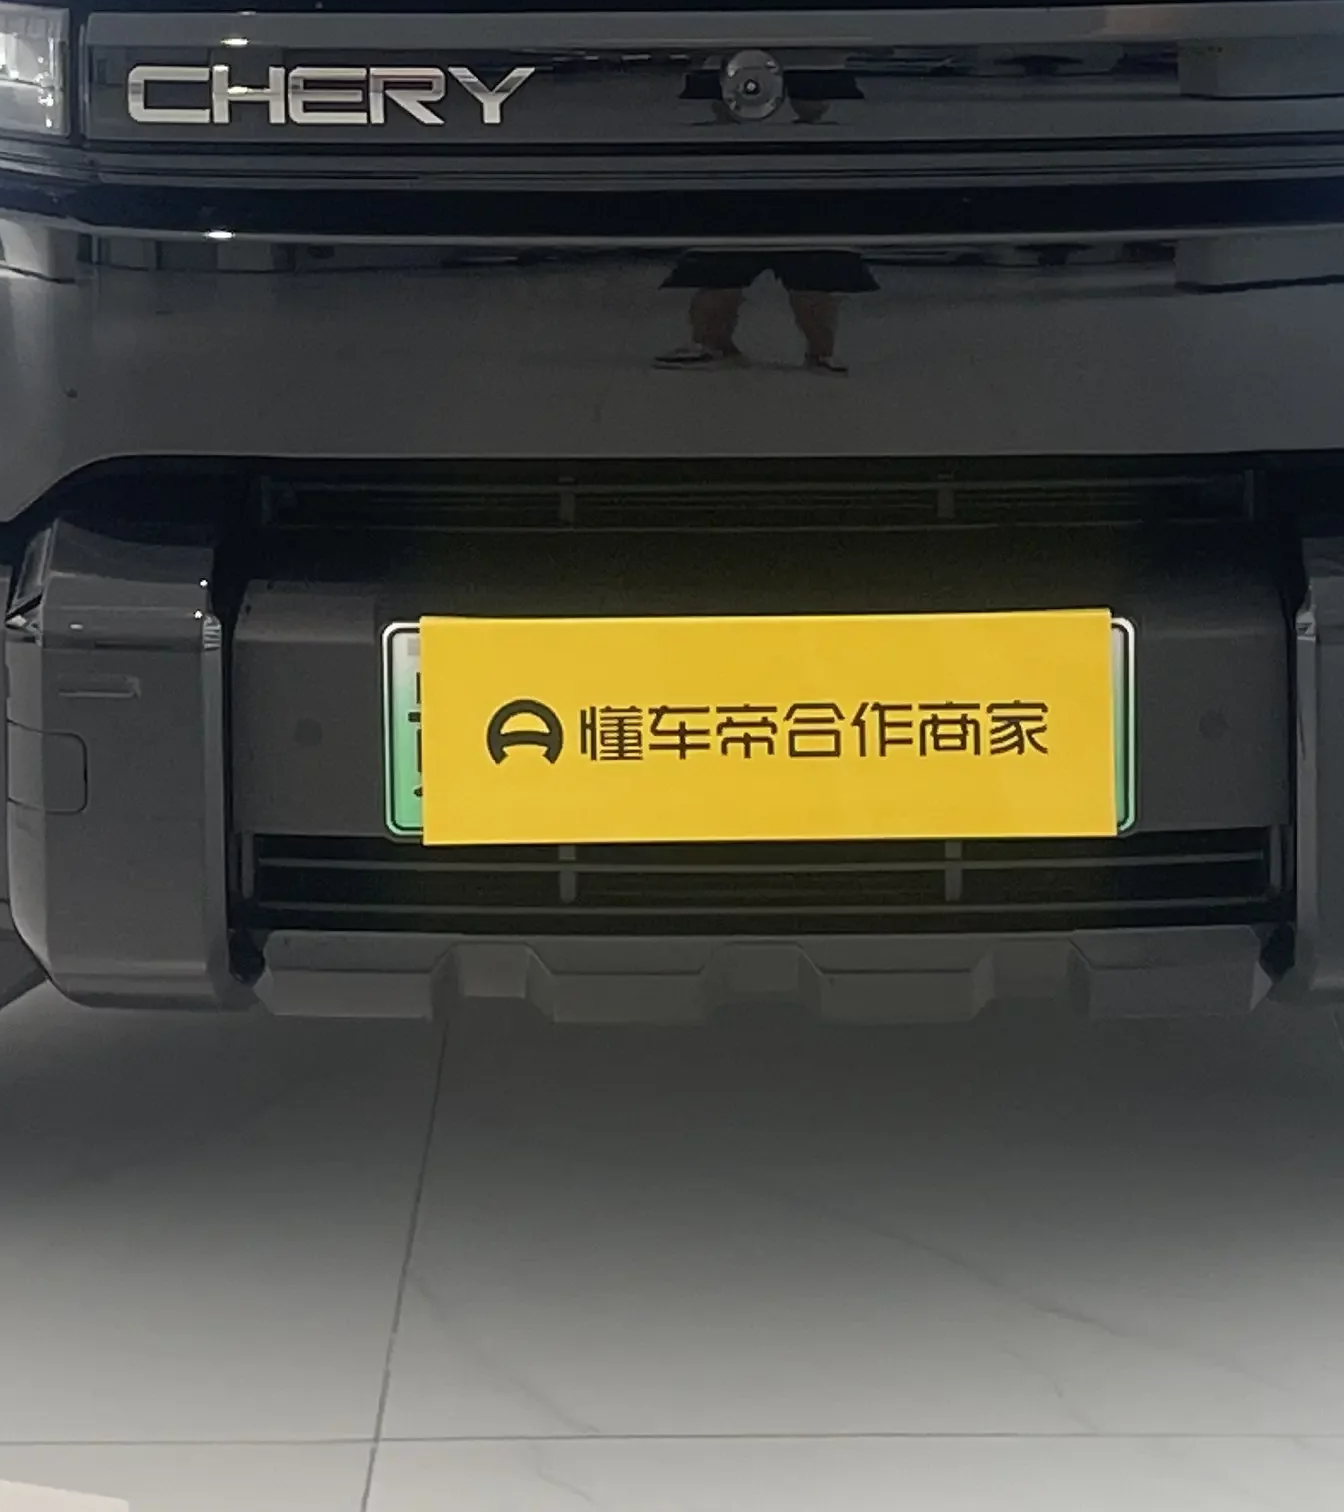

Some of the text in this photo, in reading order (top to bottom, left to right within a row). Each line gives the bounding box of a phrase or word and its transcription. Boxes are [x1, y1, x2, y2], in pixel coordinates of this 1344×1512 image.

[127, 64, 535, 124] CHERY
[579, 699, 1049, 762] 懂车帝合作商家
